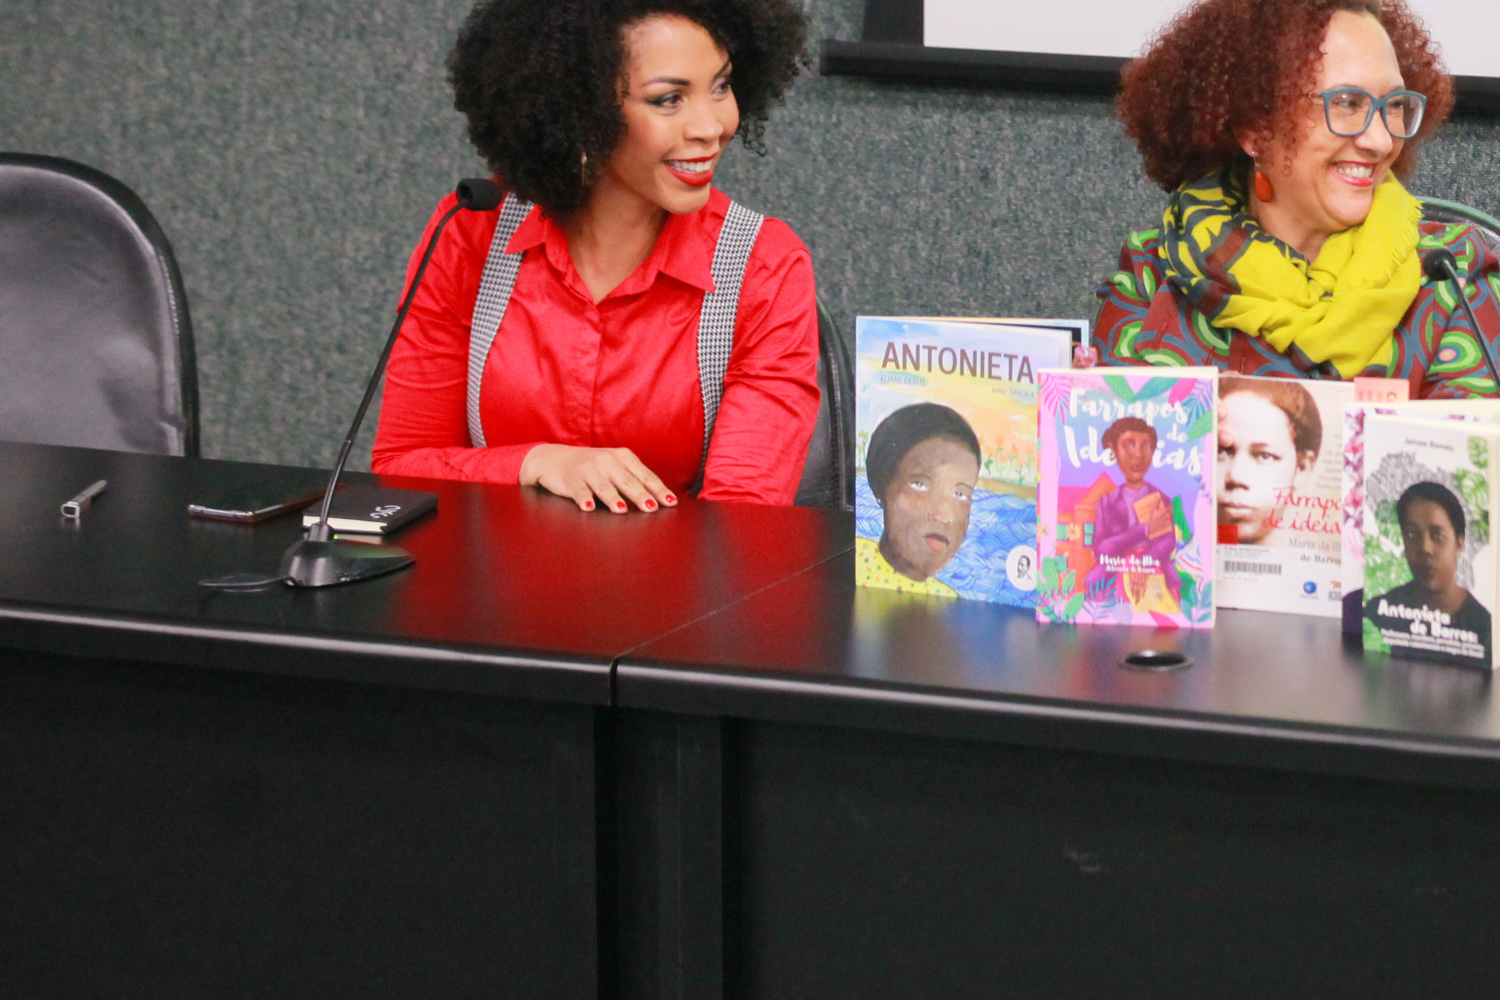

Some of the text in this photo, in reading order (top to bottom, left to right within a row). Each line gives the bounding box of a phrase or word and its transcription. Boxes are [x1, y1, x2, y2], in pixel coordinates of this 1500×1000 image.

[881, 341, 1035, 385] ANTONIETA
[879, 374, 902, 384] ELIANE
[1069, 387, 1191, 426] Farrapos
[1166, 422, 1188, 443] de
[1273, 485, 1341, 519] Farrapo
[1261, 507, 1341, 534] de ideia
[1313, 554, 1341, 564] Barro
[1377, 598, 1451, 626] Antonieta
[1409, 617, 1428, 636] de
